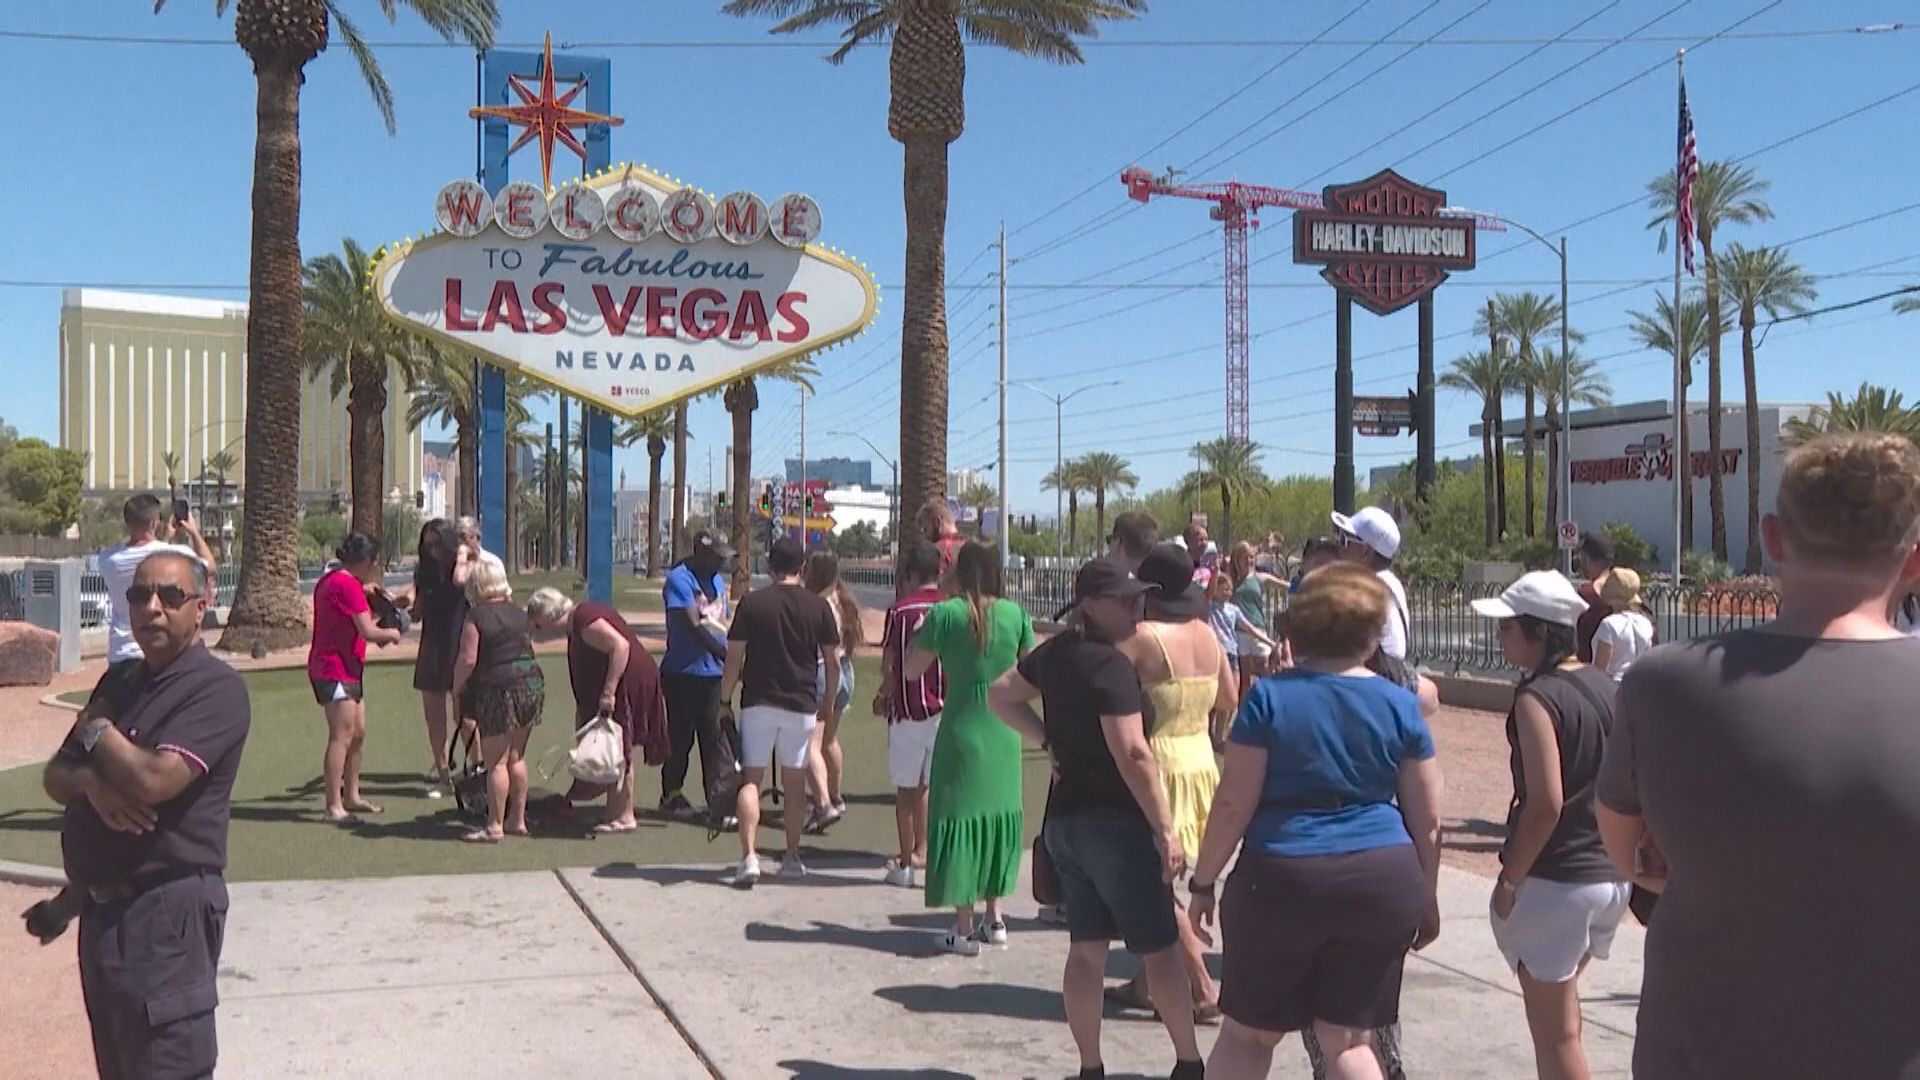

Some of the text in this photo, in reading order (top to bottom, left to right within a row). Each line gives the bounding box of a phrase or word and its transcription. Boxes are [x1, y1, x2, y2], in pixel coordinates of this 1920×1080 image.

[443, 191, 808, 238] WELCOME
[1349, 186, 1428, 215] MOTOR
[1311, 221, 1467, 258] HARLEY-DAVIDSON
[483, 243, 763, 280] TO Fabulous
[444, 277, 810, 342] LAS VEGAS
[556, 350, 695, 373] NEVADA
